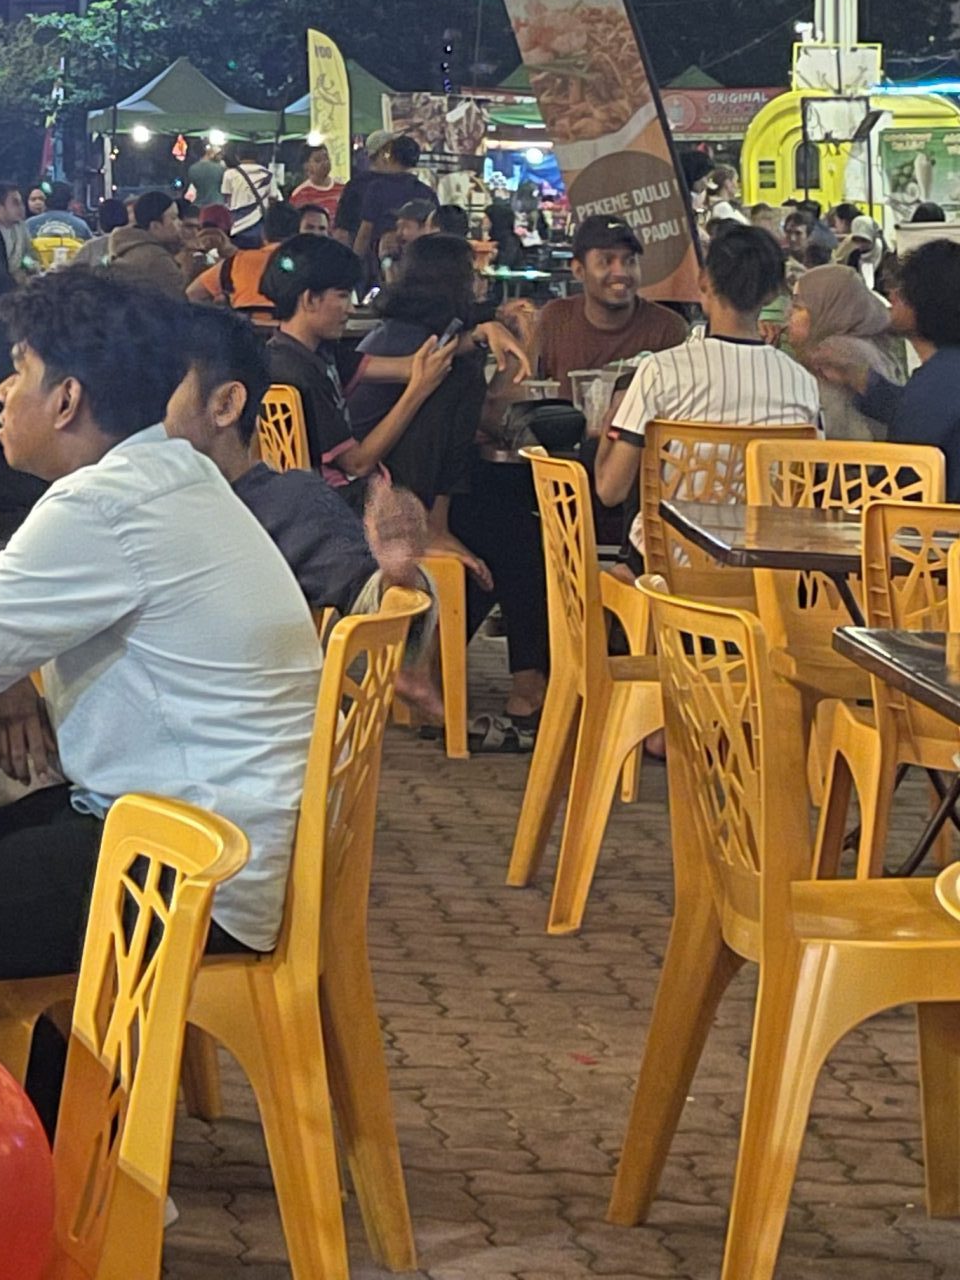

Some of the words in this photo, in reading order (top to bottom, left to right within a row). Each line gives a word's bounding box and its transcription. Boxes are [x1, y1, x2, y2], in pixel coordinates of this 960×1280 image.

[707, 91, 769, 104] ORIGINAL
[632, 181, 671, 206] DULU
[641, 219, 680, 245] PADU
